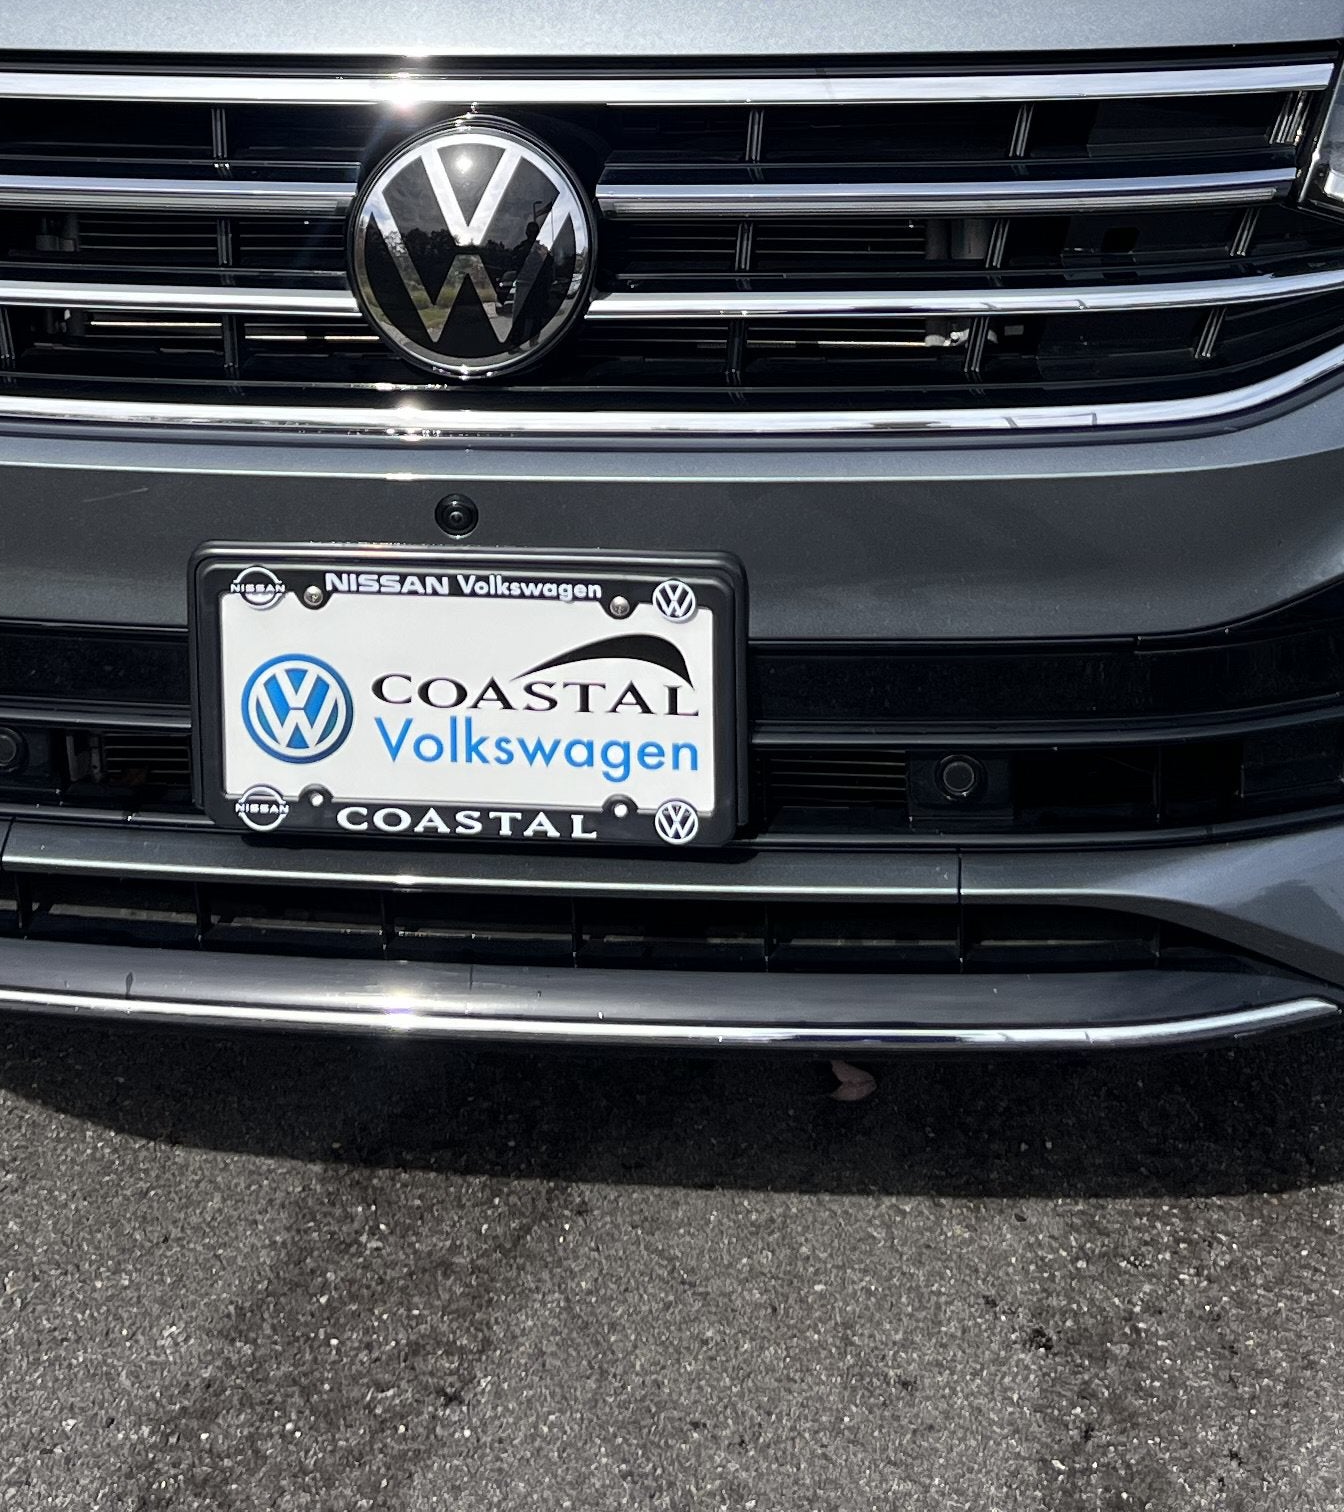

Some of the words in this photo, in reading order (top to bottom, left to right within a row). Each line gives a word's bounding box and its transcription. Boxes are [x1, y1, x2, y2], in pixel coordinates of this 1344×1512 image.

[230, 582, 286, 595] NISSAN
[325, 571, 450, 596] NISSAN
[457, 574, 602, 603] Volkswagen
[371, 672, 700, 717] COASTAL
[374, 715, 699, 783] Volkswagen
[235, 802, 290, 815] NISSAN
[336, 805, 598, 841] COASTAL
